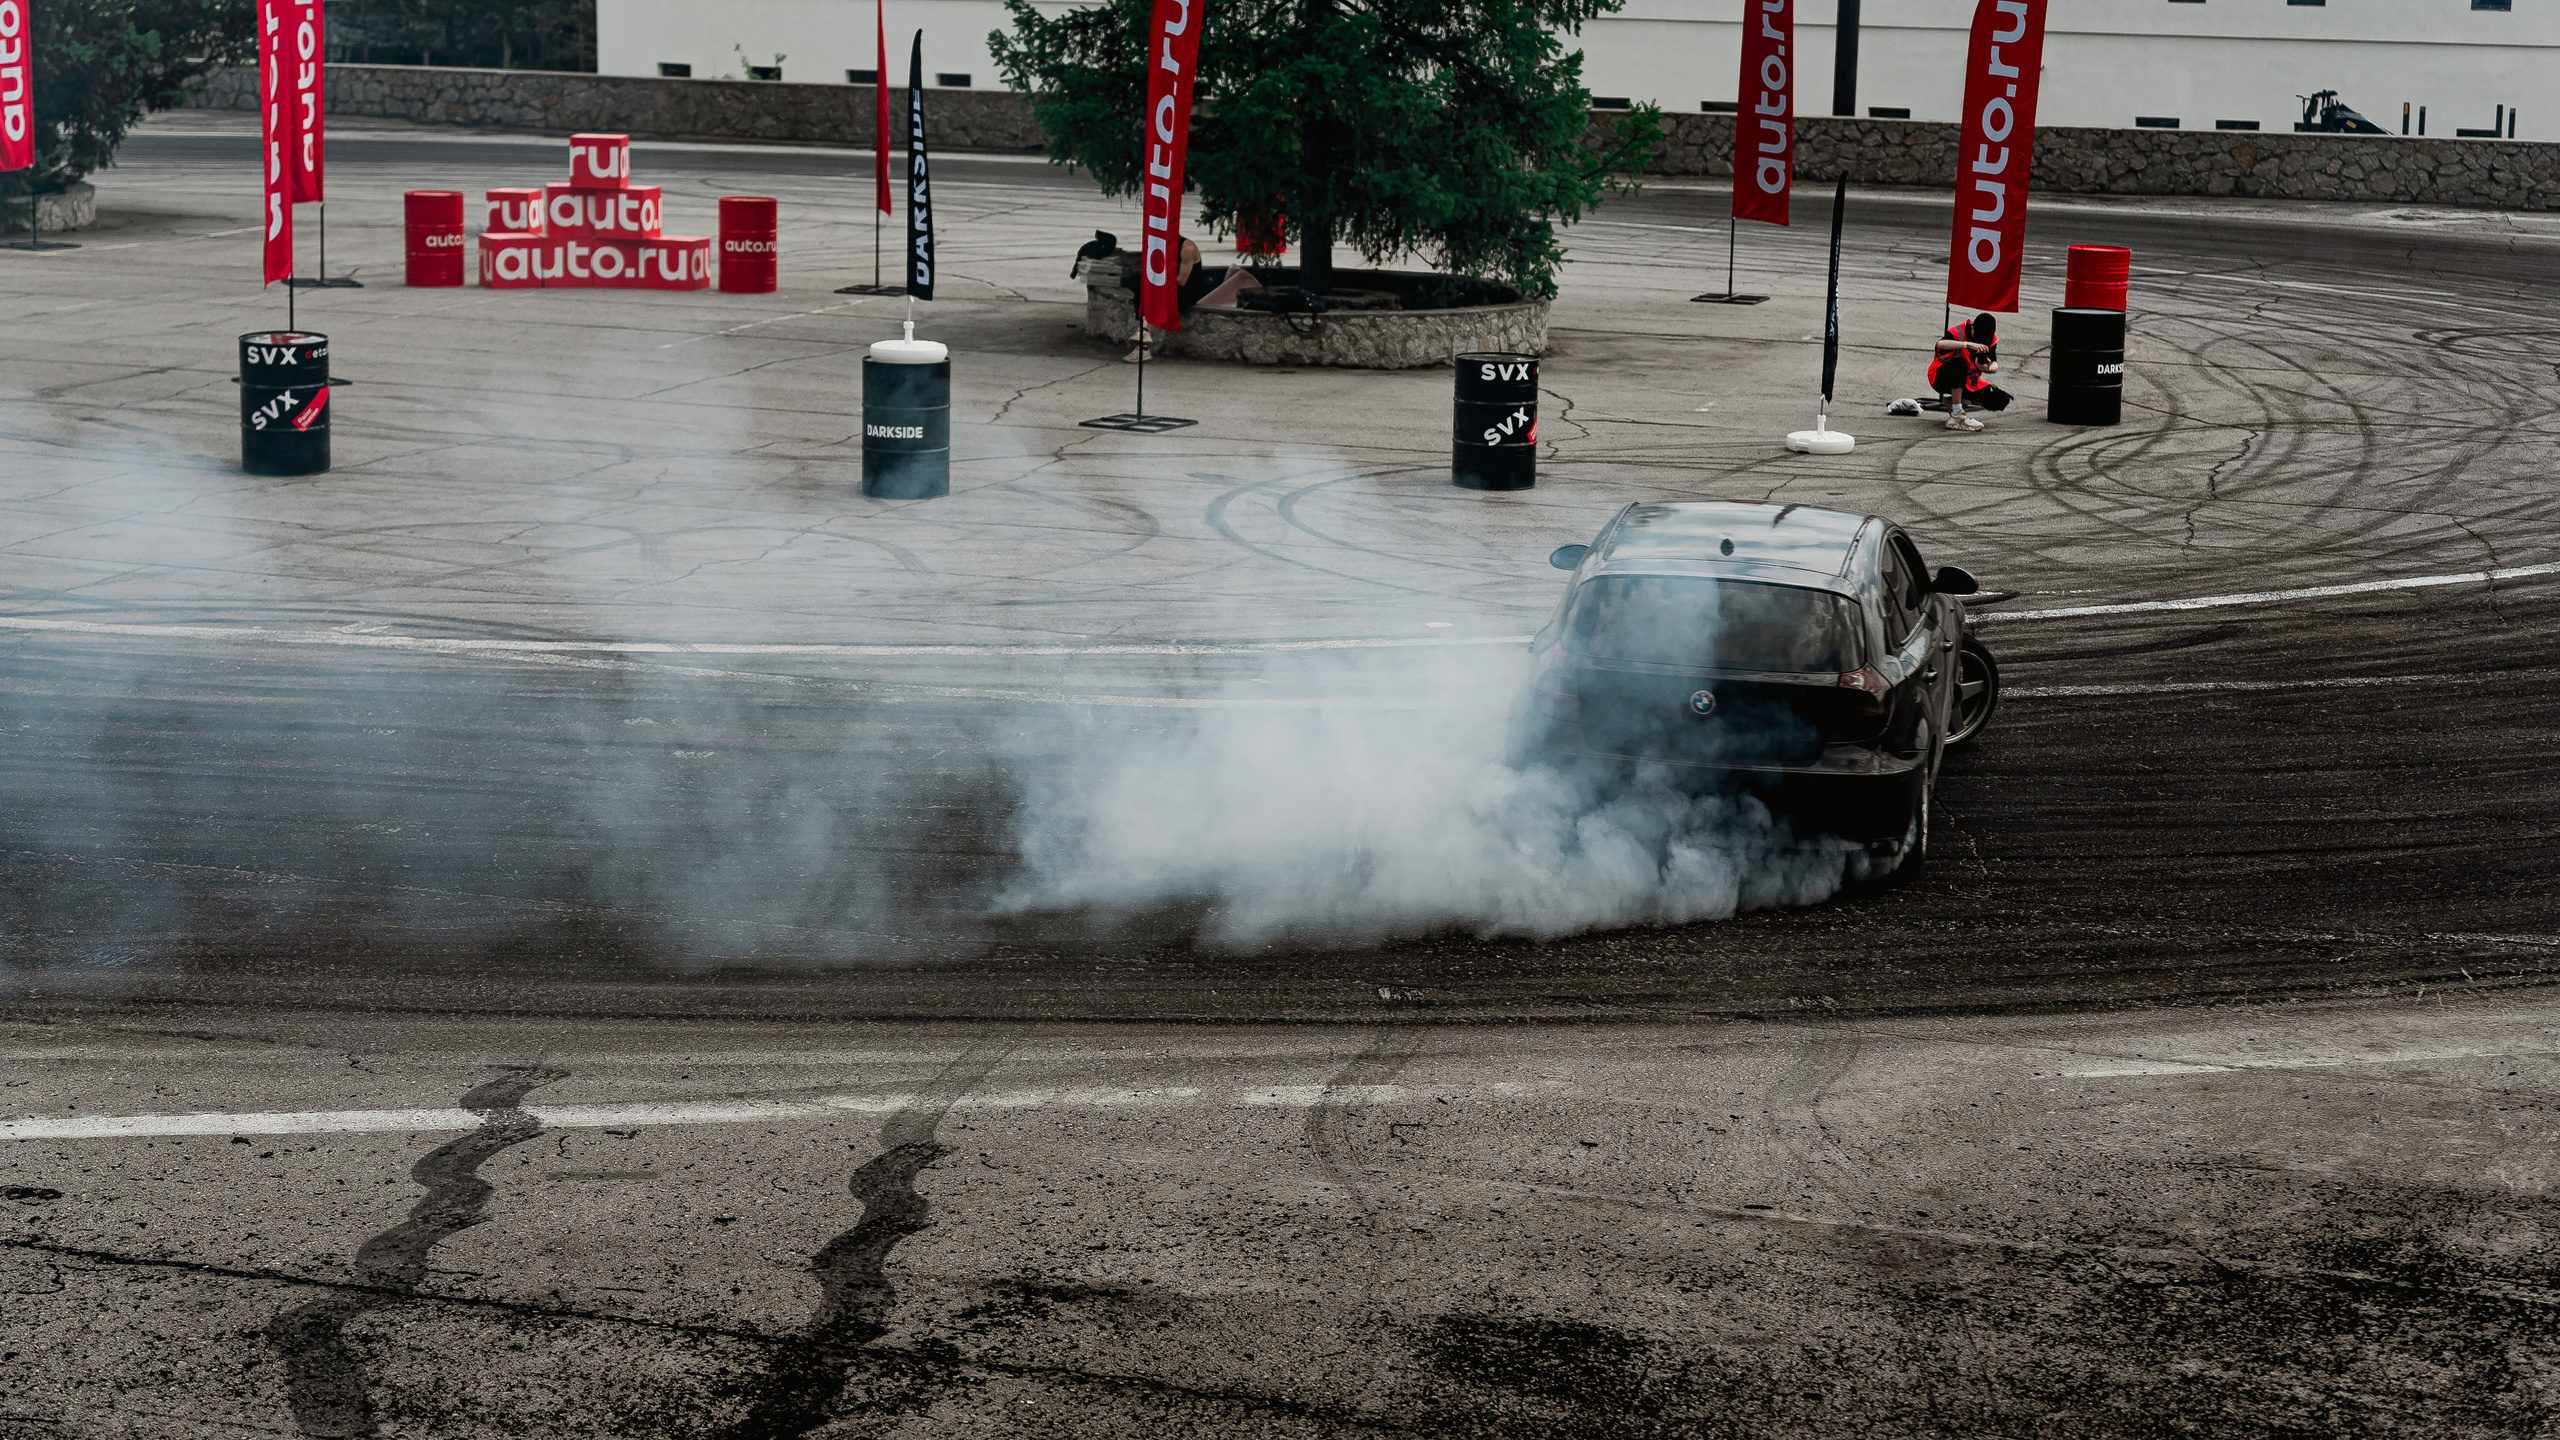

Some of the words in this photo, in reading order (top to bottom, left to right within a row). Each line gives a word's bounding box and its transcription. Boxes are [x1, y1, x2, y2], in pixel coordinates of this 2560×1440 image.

[296, 0, 316, 173] auto.
[1968, 0, 2028, 273] auto.ru
[495, 241, 688, 281] auto.ru
[725, 239, 777, 253] auto.ru
[247, 345, 298, 366] SVX
[1481, 363, 1529, 381] SVX
[251, 389, 300, 431] SVX
[1483, 406, 1530, 447] SVX
[867, 424, 924, 439] DARKSIDE
